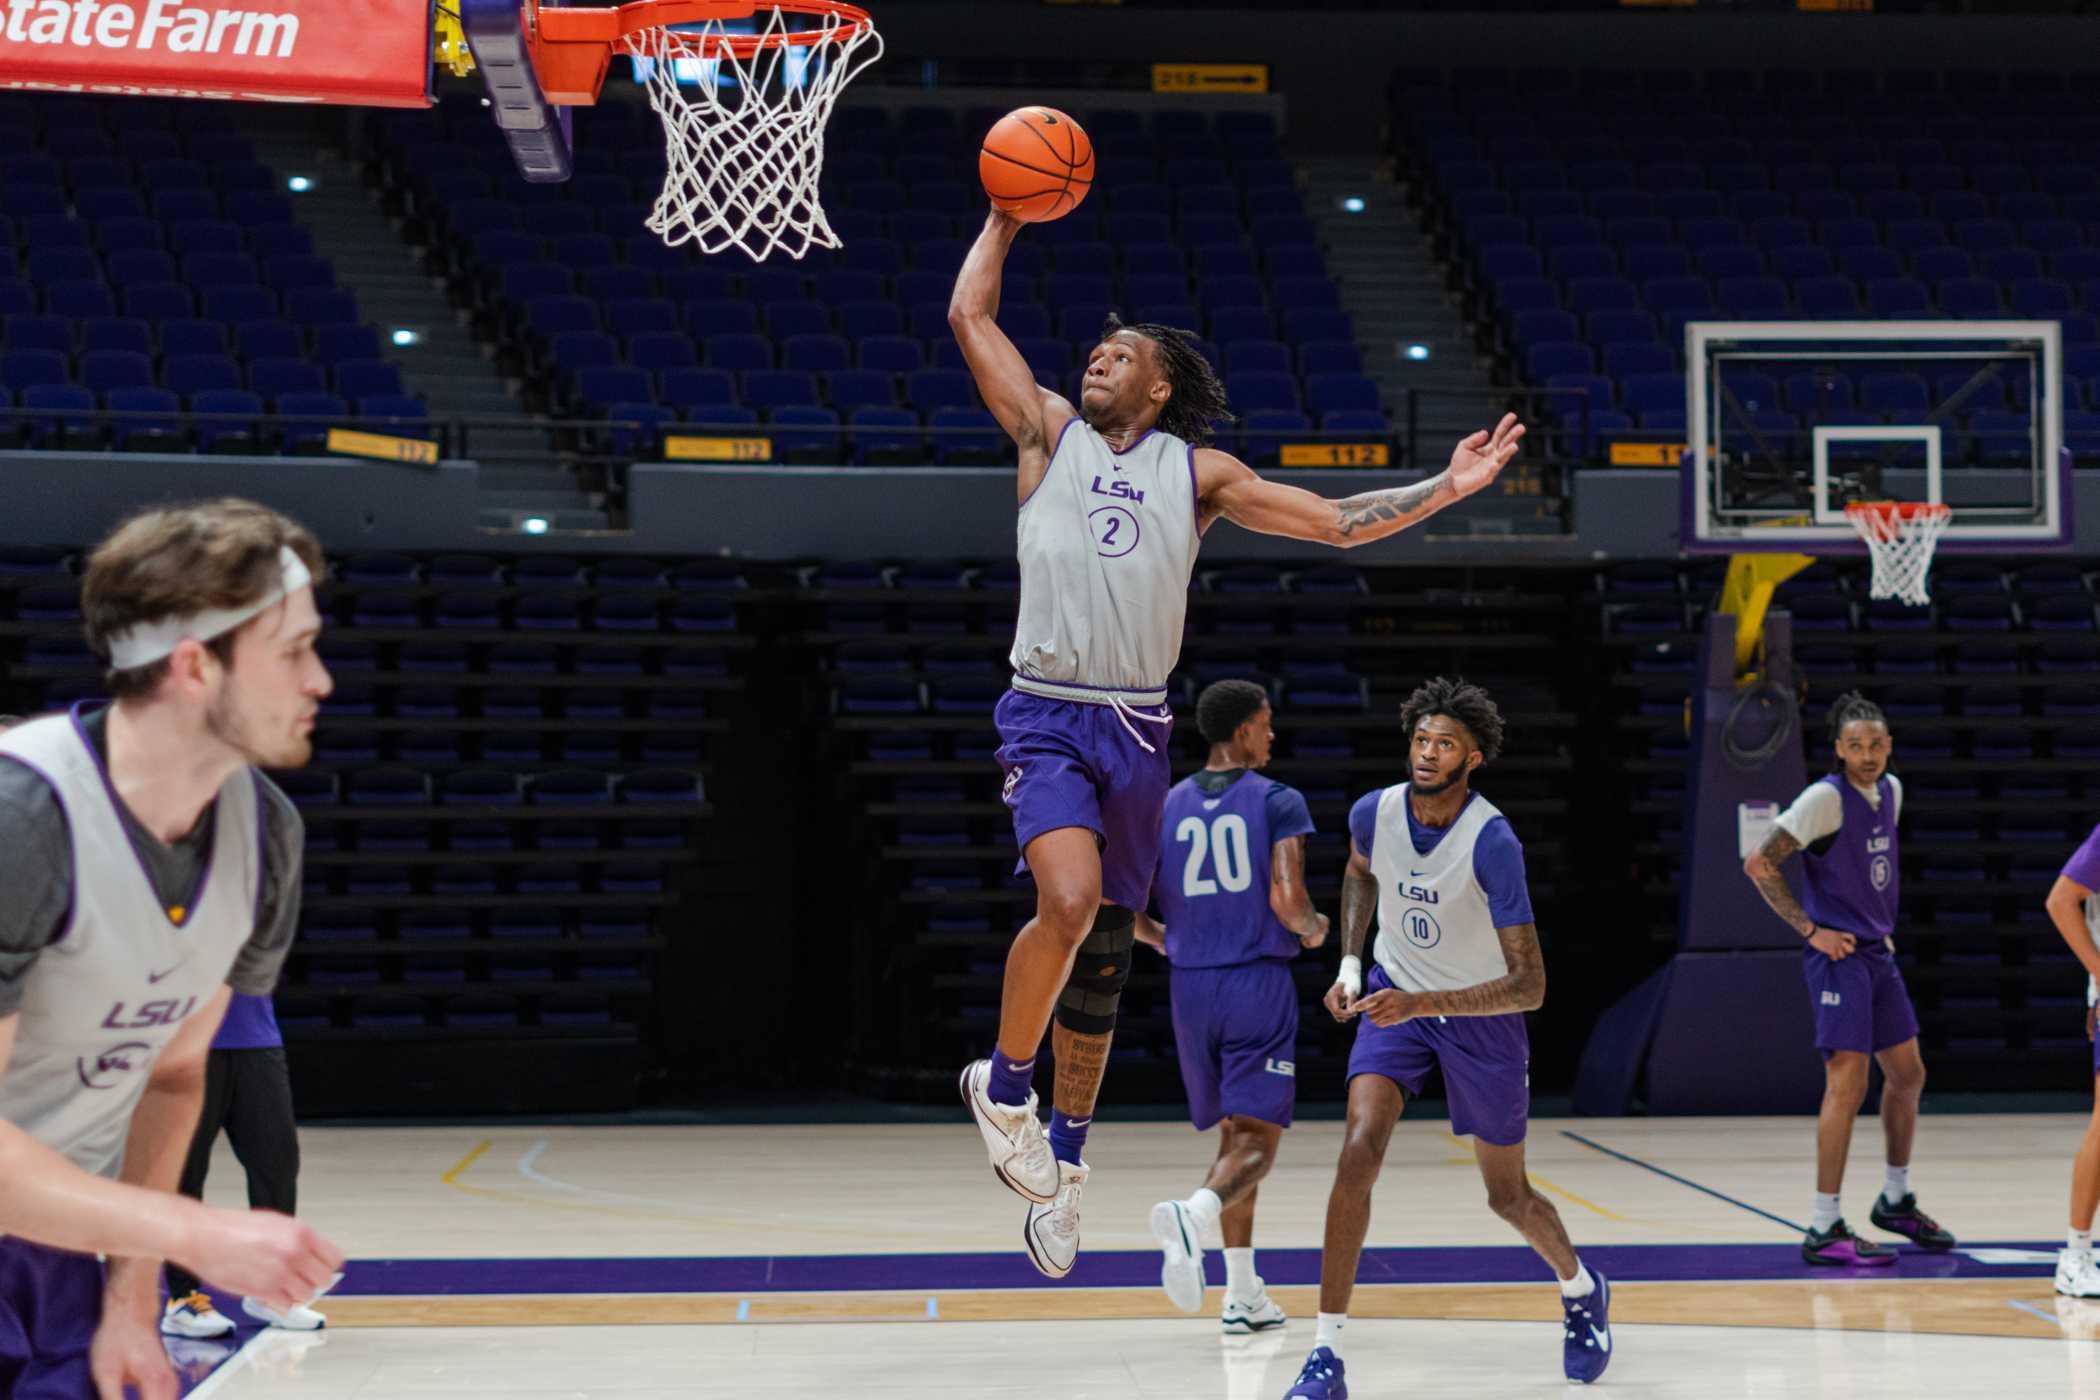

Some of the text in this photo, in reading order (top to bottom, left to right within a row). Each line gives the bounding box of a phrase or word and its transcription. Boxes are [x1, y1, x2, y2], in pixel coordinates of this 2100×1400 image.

[1329, 446, 1377, 466] 112
[1091, 475, 1145, 505] LSU
[1102, 517, 1120, 546] 2
[1176, 814, 1252, 897] 20
[1398, 882, 1439, 904] LSU
[1412, 916, 1429, 940] 10
[101, 995, 197, 1029] LSU
[1265, 1058, 1295, 1077] LS
